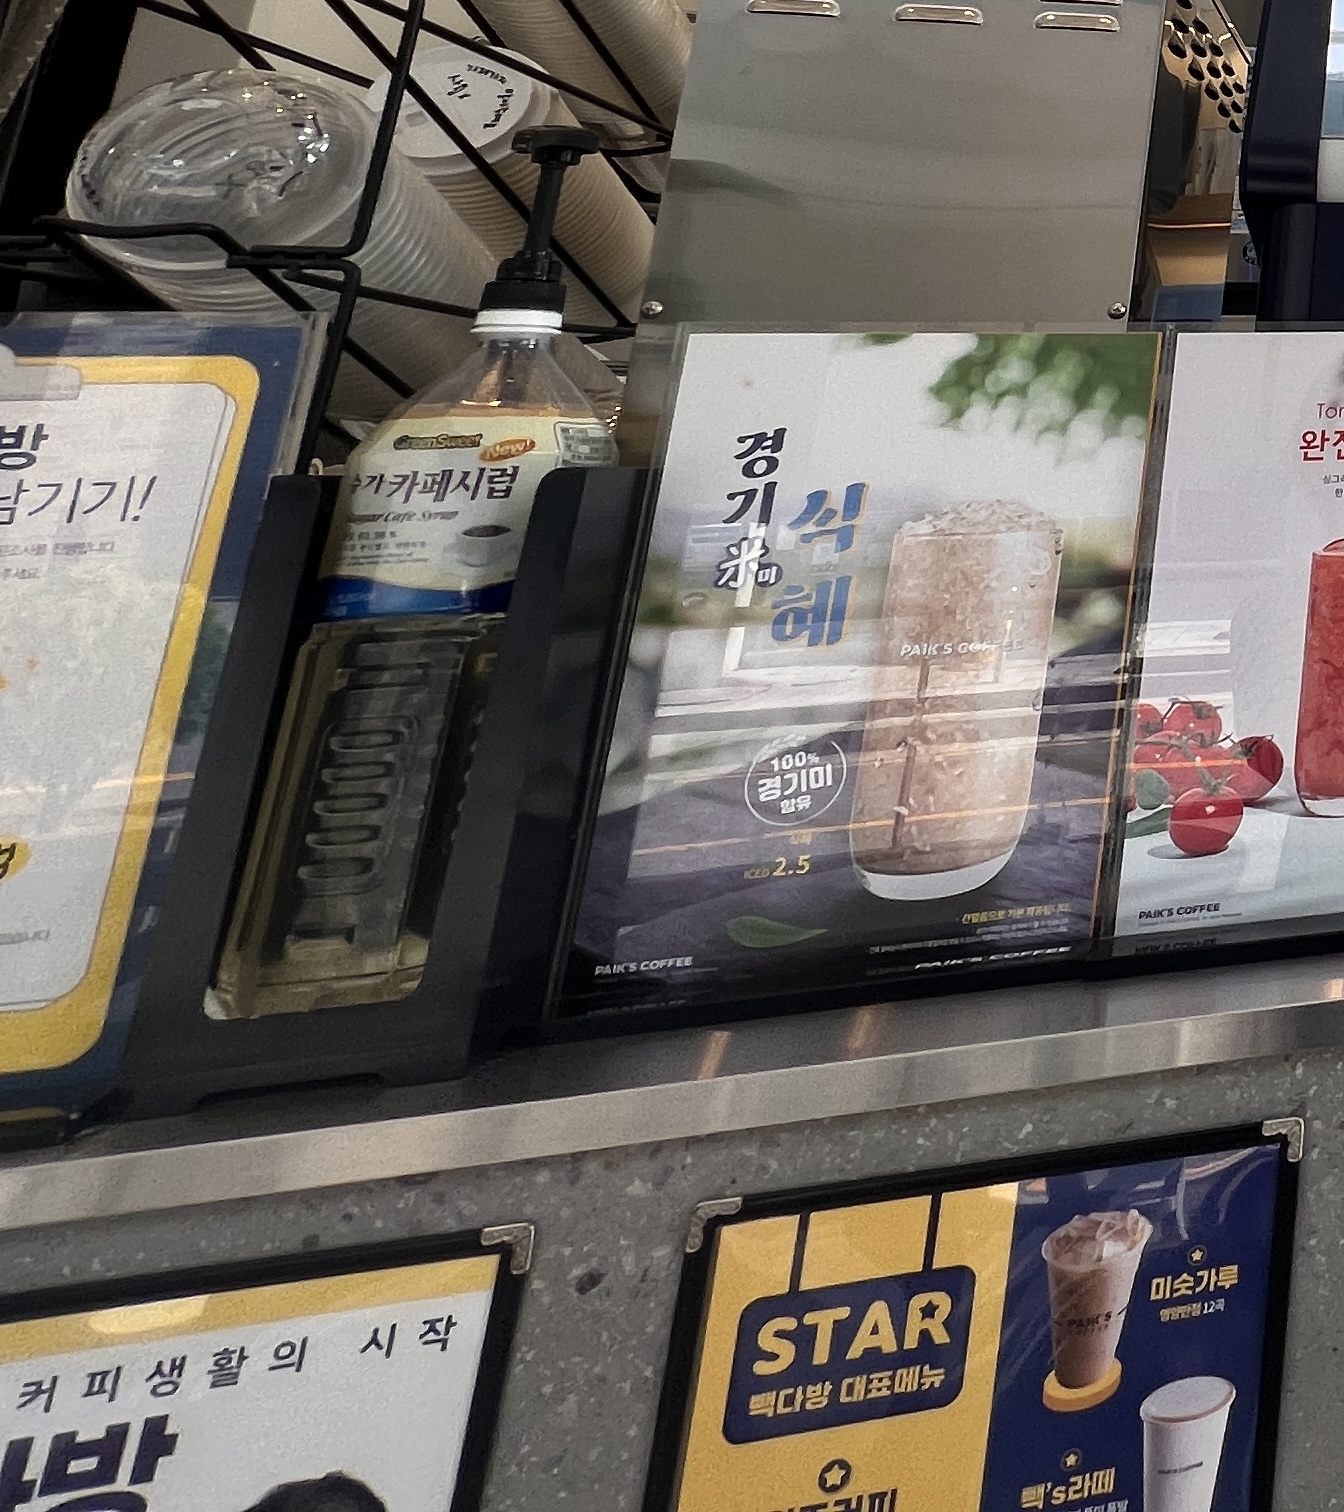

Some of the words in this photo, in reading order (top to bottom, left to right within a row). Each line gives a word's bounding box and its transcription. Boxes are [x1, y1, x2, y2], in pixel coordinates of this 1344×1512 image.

[387, 466, 520, 504] 카페시럽
[770, 481, 872, 648] 식혜
[900, 639, 955, 658] PAIK'S
[770, 751, 820, 771] 100%
[758, 763, 832, 802] 경기미
[773, 855, 811, 877] 2.5
[1138, 903, 1174, 921] PAIK'S
[1176, 902, 1221, 917] COFFEE
[594, 961, 637, 976] PAIK'S
[640, 956, 694, 971] COFFEE
[1149, 1264, 1239, 1302] 미숫가루
[752, 1289, 954, 1378] STAR
[748, 1380, 833, 1418] 빽다방
[839, 1363, 946, 1405] 대표메뉴
[1020, 1467, 1116, 1510] 빽's라떼
